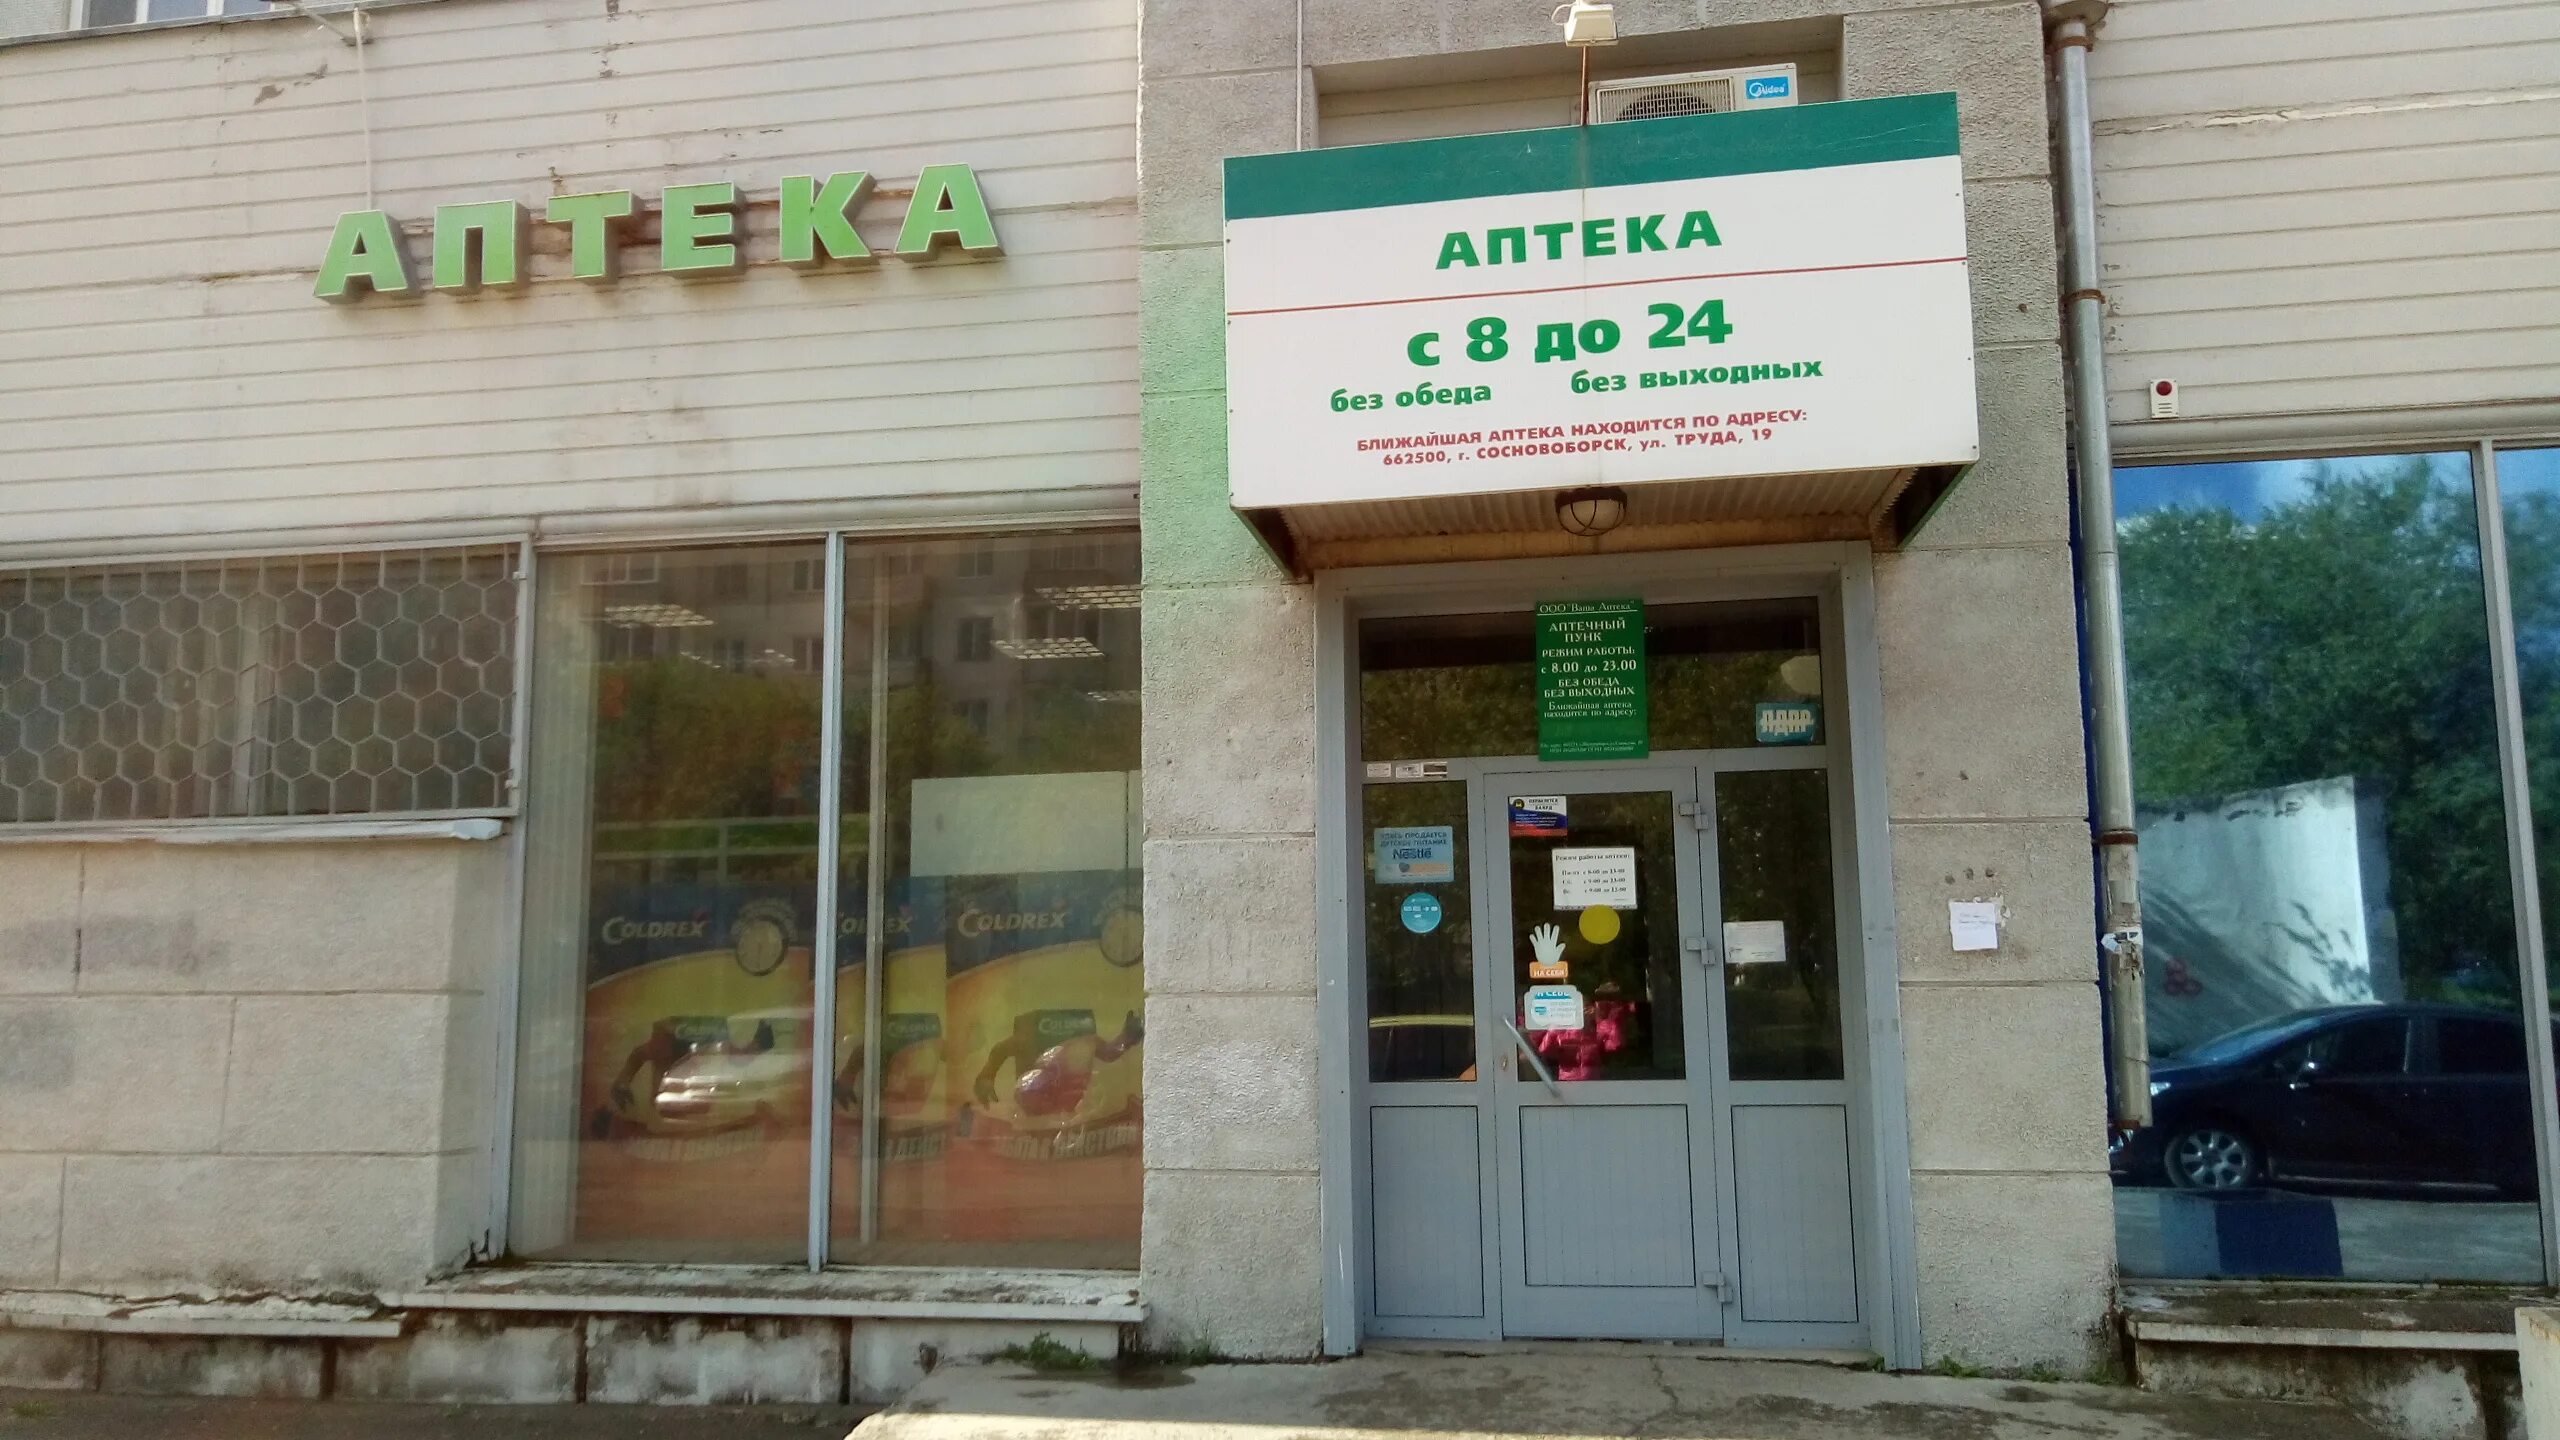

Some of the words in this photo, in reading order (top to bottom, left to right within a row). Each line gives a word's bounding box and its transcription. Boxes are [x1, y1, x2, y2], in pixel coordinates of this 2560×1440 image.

[1749, 82, 1785, 97] Midea
[313, 163, 1000, 299] АПТЕКА
[1435, 210, 1722, 270] АПТЕКА
[1406, 330, 1440, 367] с
[1466, 316, 1509, 363] 8
[1535, 319, 1622, 364] до
[1647, 299, 1734, 350] 24
[1570, 369, 1628, 395] без
[1640, 357, 1824, 391] выходных
[1330, 388, 1384, 412] без
[1395, 382, 1492, 407] обеда
[1357, 431, 1481, 451] БЛИЖАЙШАЯ
[1489, 424, 1565, 442] АПТЕКА
[1571, 416, 1686, 436] НАХОДИТСЯ
[1692, 414, 1719, 428] ПО
[1726, 410, 1808, 426] АДРЕСУ:
[1383, 451, 1451, 466] 662500,
[1458, 451, 1470, 461] г.
[1476, 438, 1633, 460] СОСНОВОБОРСК,
[1639, 438, 1666, 452] ул.
[1675, 431, 1743, 447] ТРУДА,
[1752, 428, 1772, 440] 19
[1540, 604, 1566, 613] ООО
[1549, 617, 1626, 632] АПТЕЧНЫЙ
[1565, 632, 1602, 643] ПУНК
[1542, 648, 1583, 658] РЕЖИМ
[1586, 646, 1635, 656] РАБОТЫ:
[1551, 661, 1579, 673] 8.00
[1584, 665, 1598, 673] до
[1602, 660, 1637, 671] 23.00
[1558, 679, 1579, 688] БЕЗ
[1583, 677, 1620, 687] ОБЕДА
[1544, 689, 1565, 699] БЕЗ
[1568, 686, 1635, 698] ВЫХОДНЫХ
